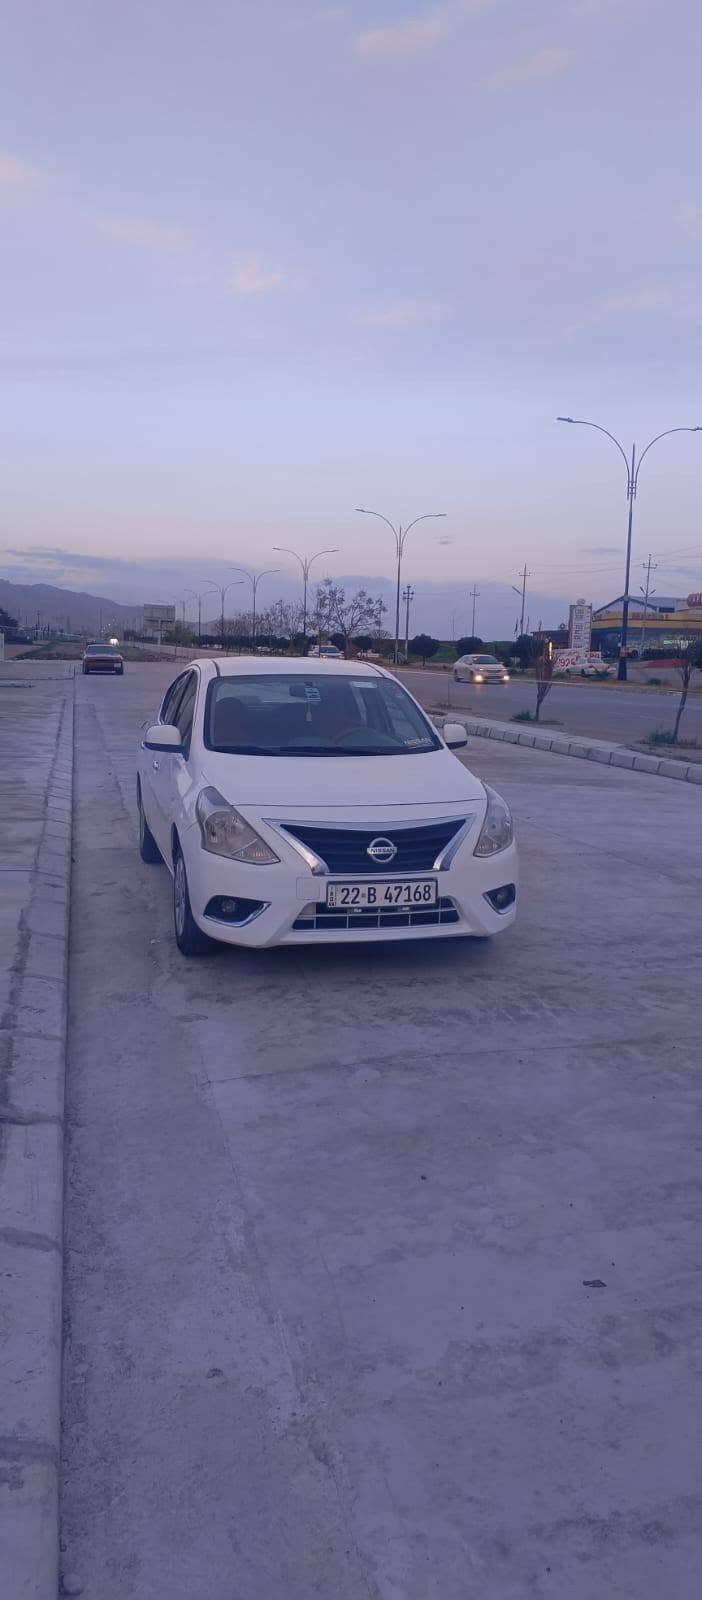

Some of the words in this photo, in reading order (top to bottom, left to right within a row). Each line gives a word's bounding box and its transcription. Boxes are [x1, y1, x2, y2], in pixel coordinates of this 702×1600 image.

[341, 887, 360, 905] 22
[367, 886, 377, 904] B
[383, 884, 431, 903] 47168
